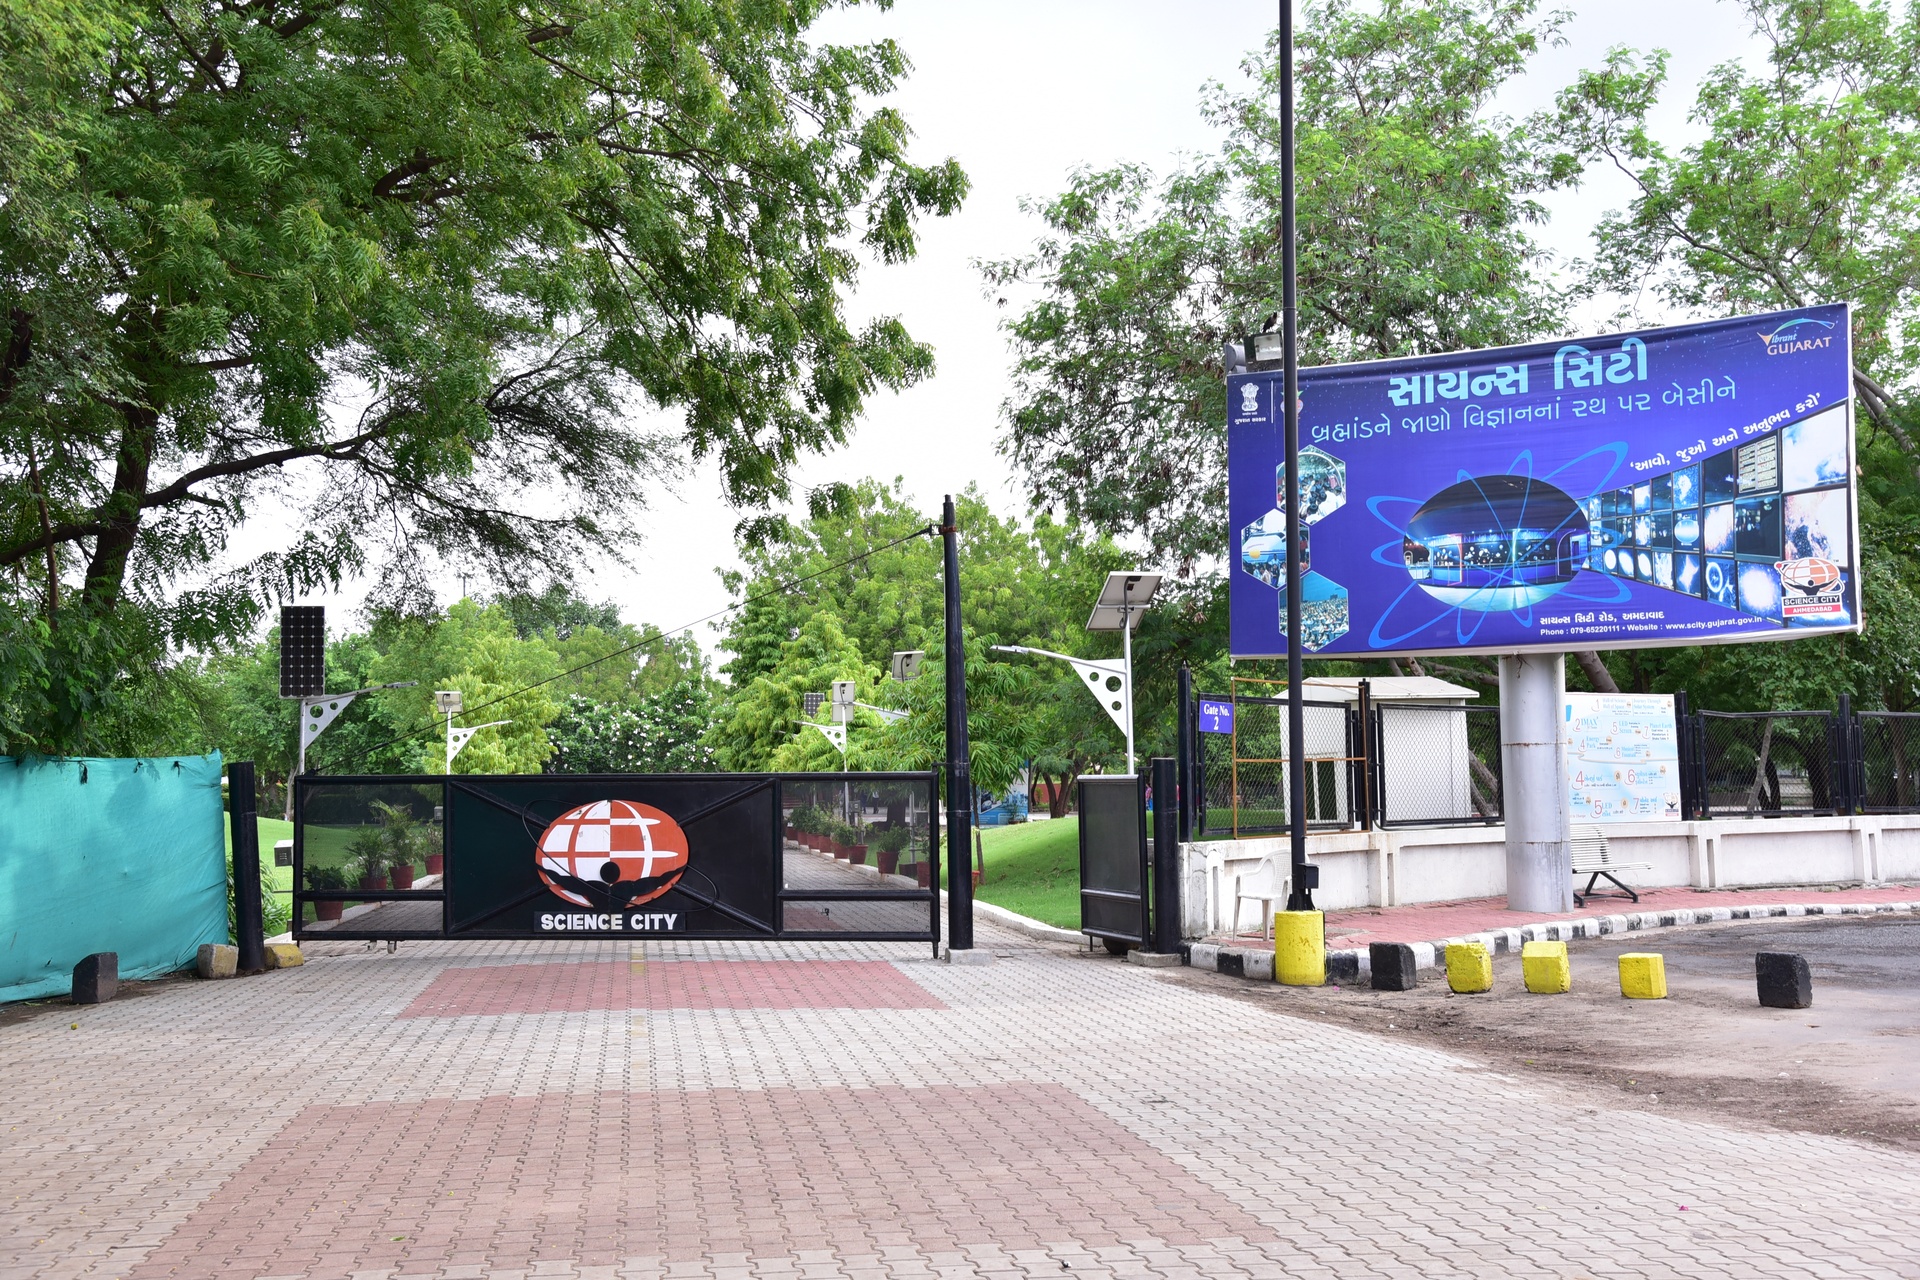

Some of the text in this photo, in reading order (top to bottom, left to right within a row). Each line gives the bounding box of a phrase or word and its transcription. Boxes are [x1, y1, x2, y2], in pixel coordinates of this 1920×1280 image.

[1767, 336, 1832, 356] GUJARAT
[1388, 337, 1648, 407] સાયન્સ સિટી
[1311, 375, 1736, 443] બ્રહ્માંડને જાણો વિજ્ઞાનનાં રથ પર બેસીને
[1675, 439, 1707, 463] જુઓ
[1711, 428, 1739, 447] અને
[1742, 409, 1791, 434] અનુભવ
[1784, 595, 1839, 606] SCIENCE CITY
[1792, 606, 1833, 614] AHMEDABAD
[1539, 611, 1665, 625] સાયન્સ સિટી રોડ, અમદાવાદ
[1570, 625, 1620, 635] 079-65220111
[1626, 623, 1659, 632] Website
[1664, 616, 1763, 631] www.scity.gujarat.gov.in
[1203, 703, 1230, 717] Gate No.
[1213, 716, 1219, 730] 2
[1575, 718, 1581, 731] 2
[1613, 721, 1618, 732] 5
[1580, 739, 1585, 749] 4
[1616, 747, 1621, 757] 6
[1575, 770, 1584, 786] 4
[1628, 769, 1635, 783] 6
[1594, 800, 1603, 815] 5
[1633, 797, 1639, 810] 7
[540, 913, 678, 931] SCIENCE CITY
